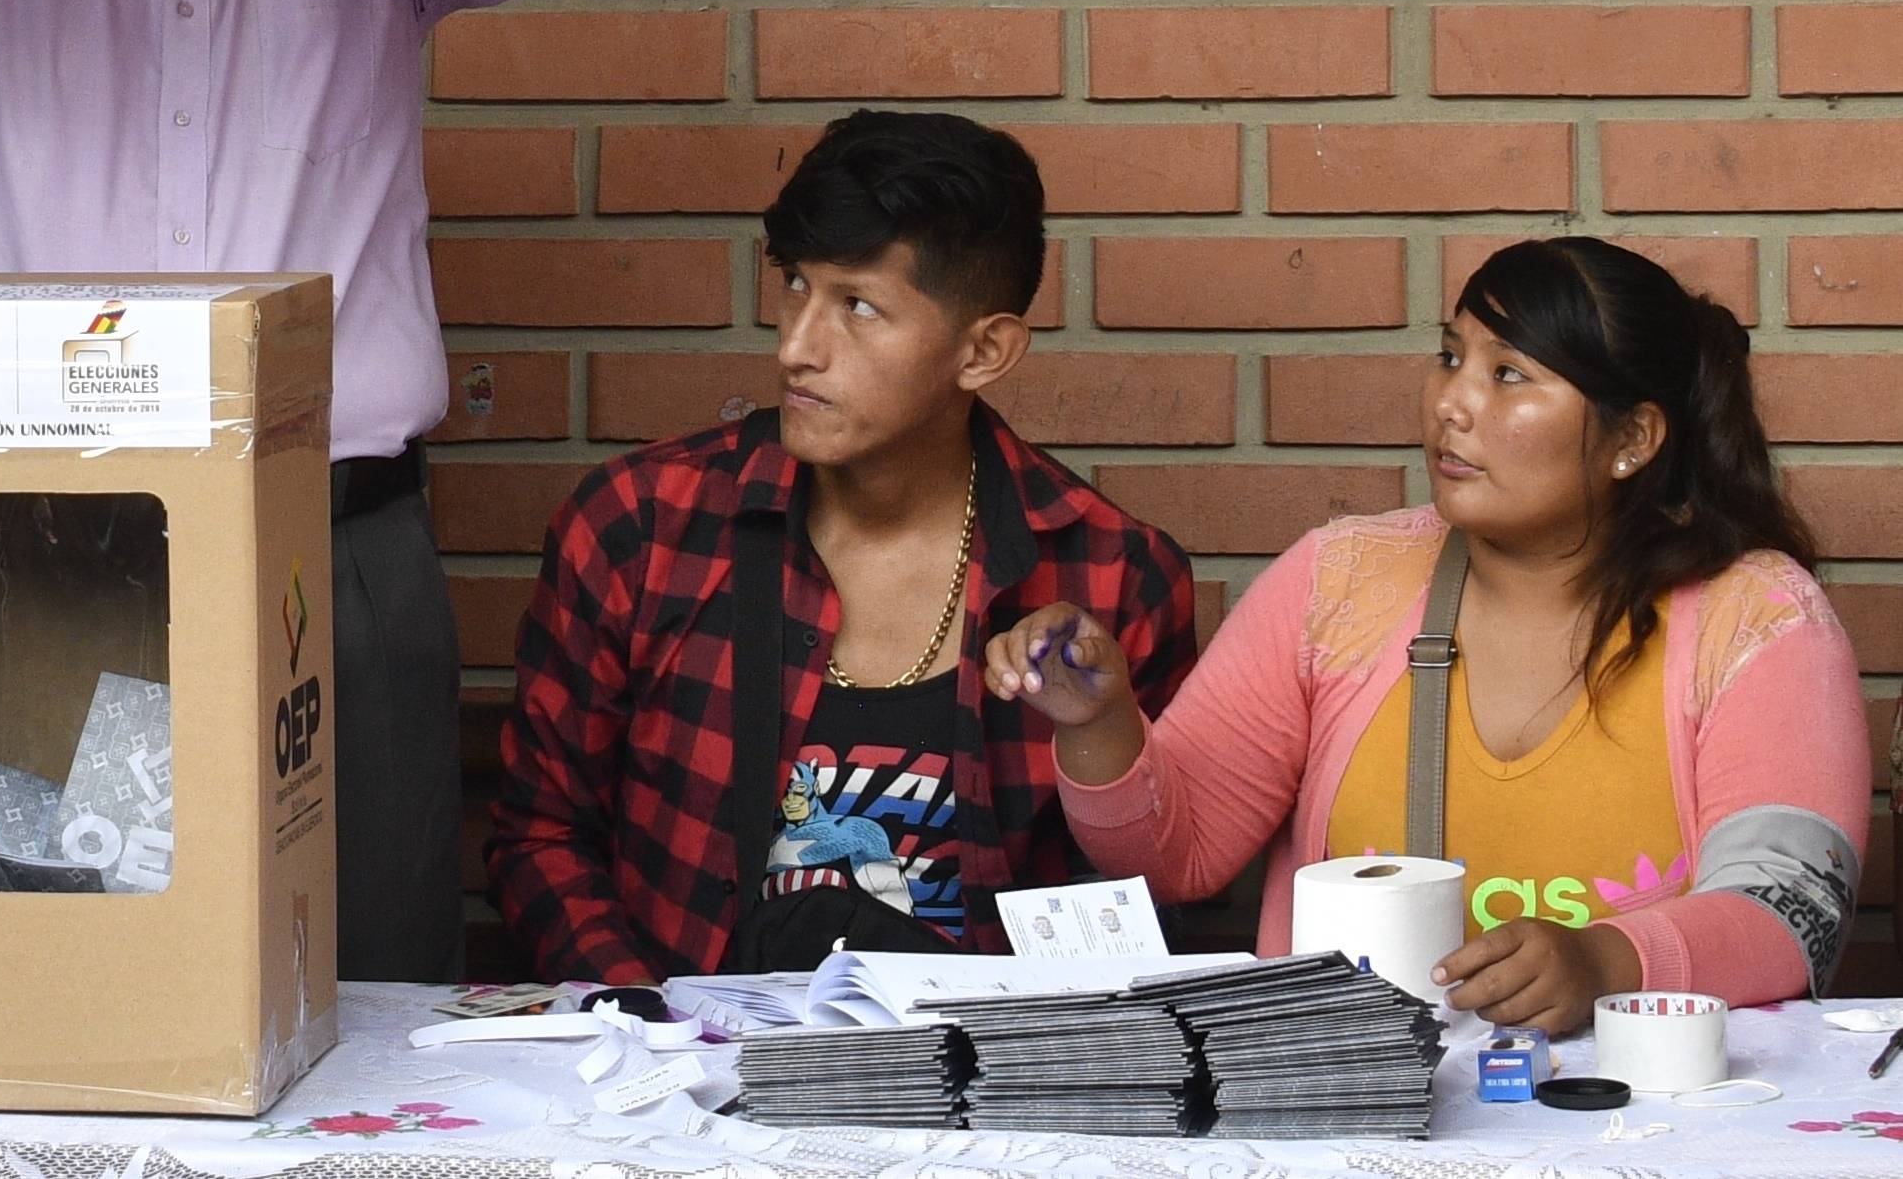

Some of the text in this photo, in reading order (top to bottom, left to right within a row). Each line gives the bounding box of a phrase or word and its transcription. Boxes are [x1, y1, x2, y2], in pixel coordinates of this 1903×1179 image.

[69, 365, 159, 379] ELECCIONES
[69, 381, 159, 394] GENERALES
[275, 677, 321, 780] OEP
